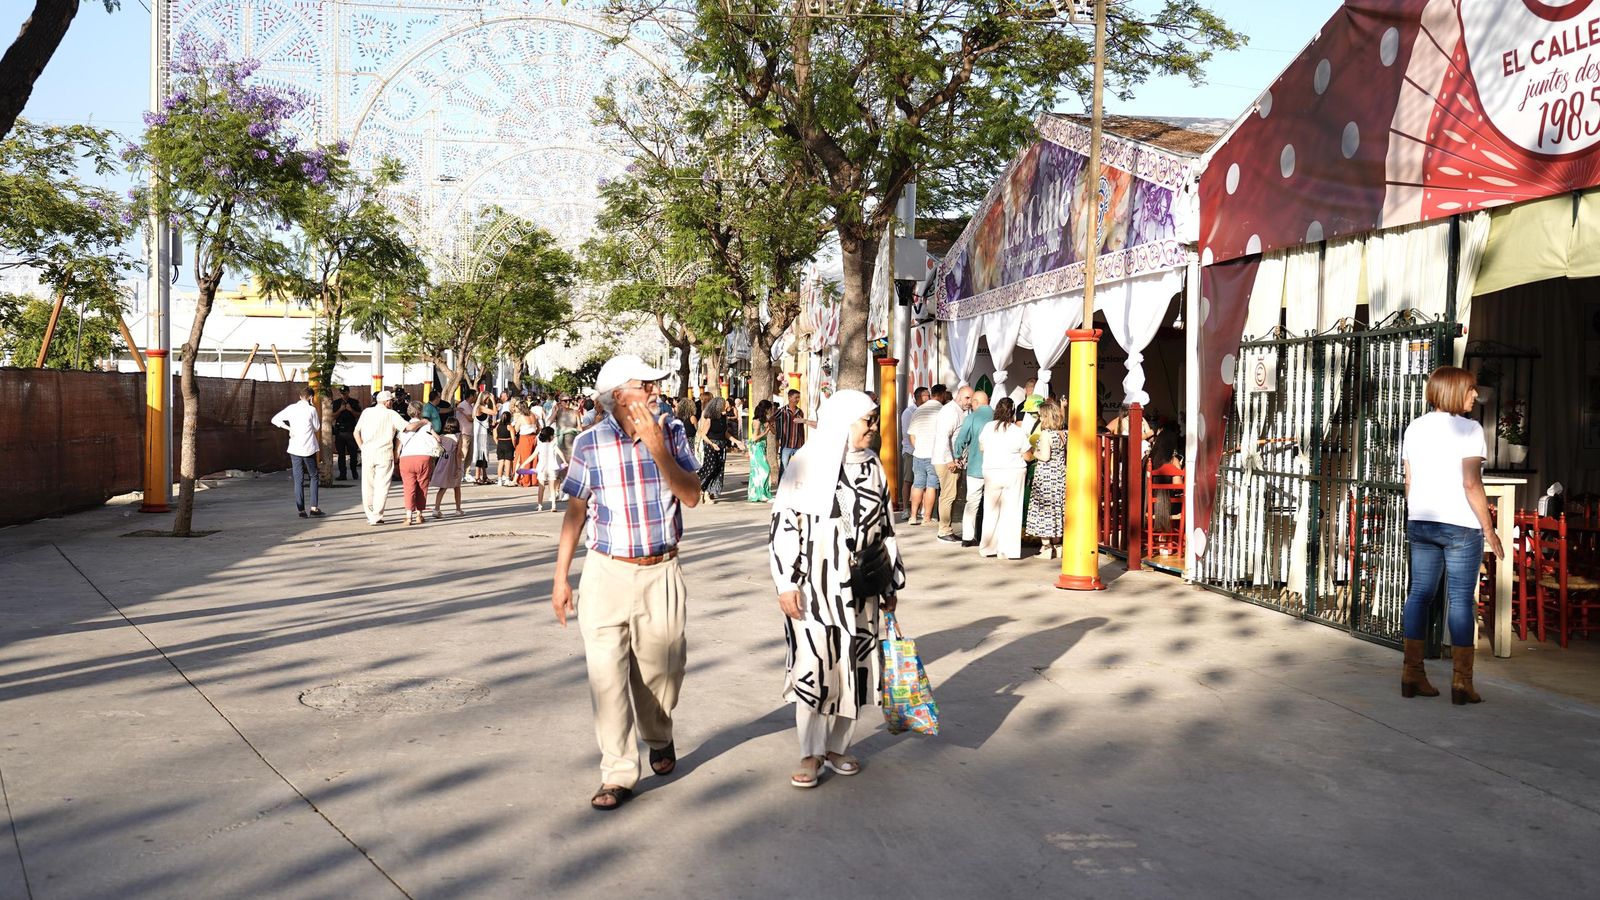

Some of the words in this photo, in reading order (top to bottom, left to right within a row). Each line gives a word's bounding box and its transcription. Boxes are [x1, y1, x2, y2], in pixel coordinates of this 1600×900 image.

[1502, 49, 1525, 77] EL
[1530, 17, 1600, 65] CALLE
[1517, 67, 1570, 112] juntos
[1537, 86, 1600, 149] 1985
